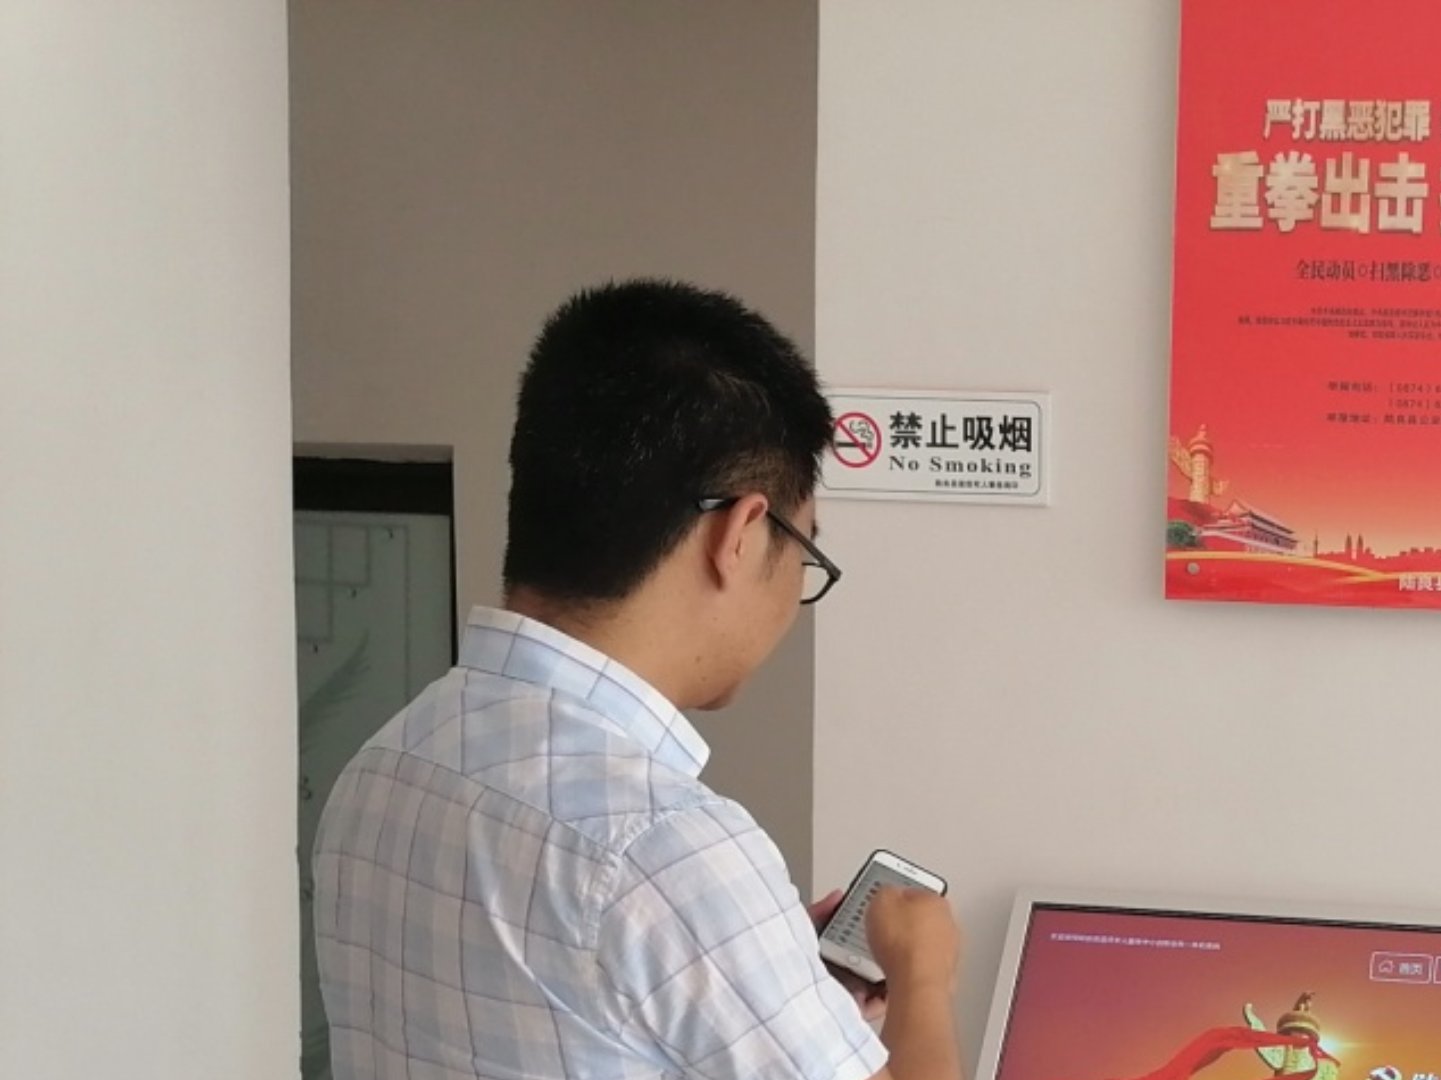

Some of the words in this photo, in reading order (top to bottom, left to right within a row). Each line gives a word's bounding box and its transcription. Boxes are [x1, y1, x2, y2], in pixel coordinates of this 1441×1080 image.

[1263, 99, 1431, 142] 严打黑恶犯罪
[1210, 151, 1429, 233] 重拳出击
[889, 411, 1033, 452] 禁止吸烟
[889, 456, 920, 472] No
[929, 456, 1032, 478] Smoking
